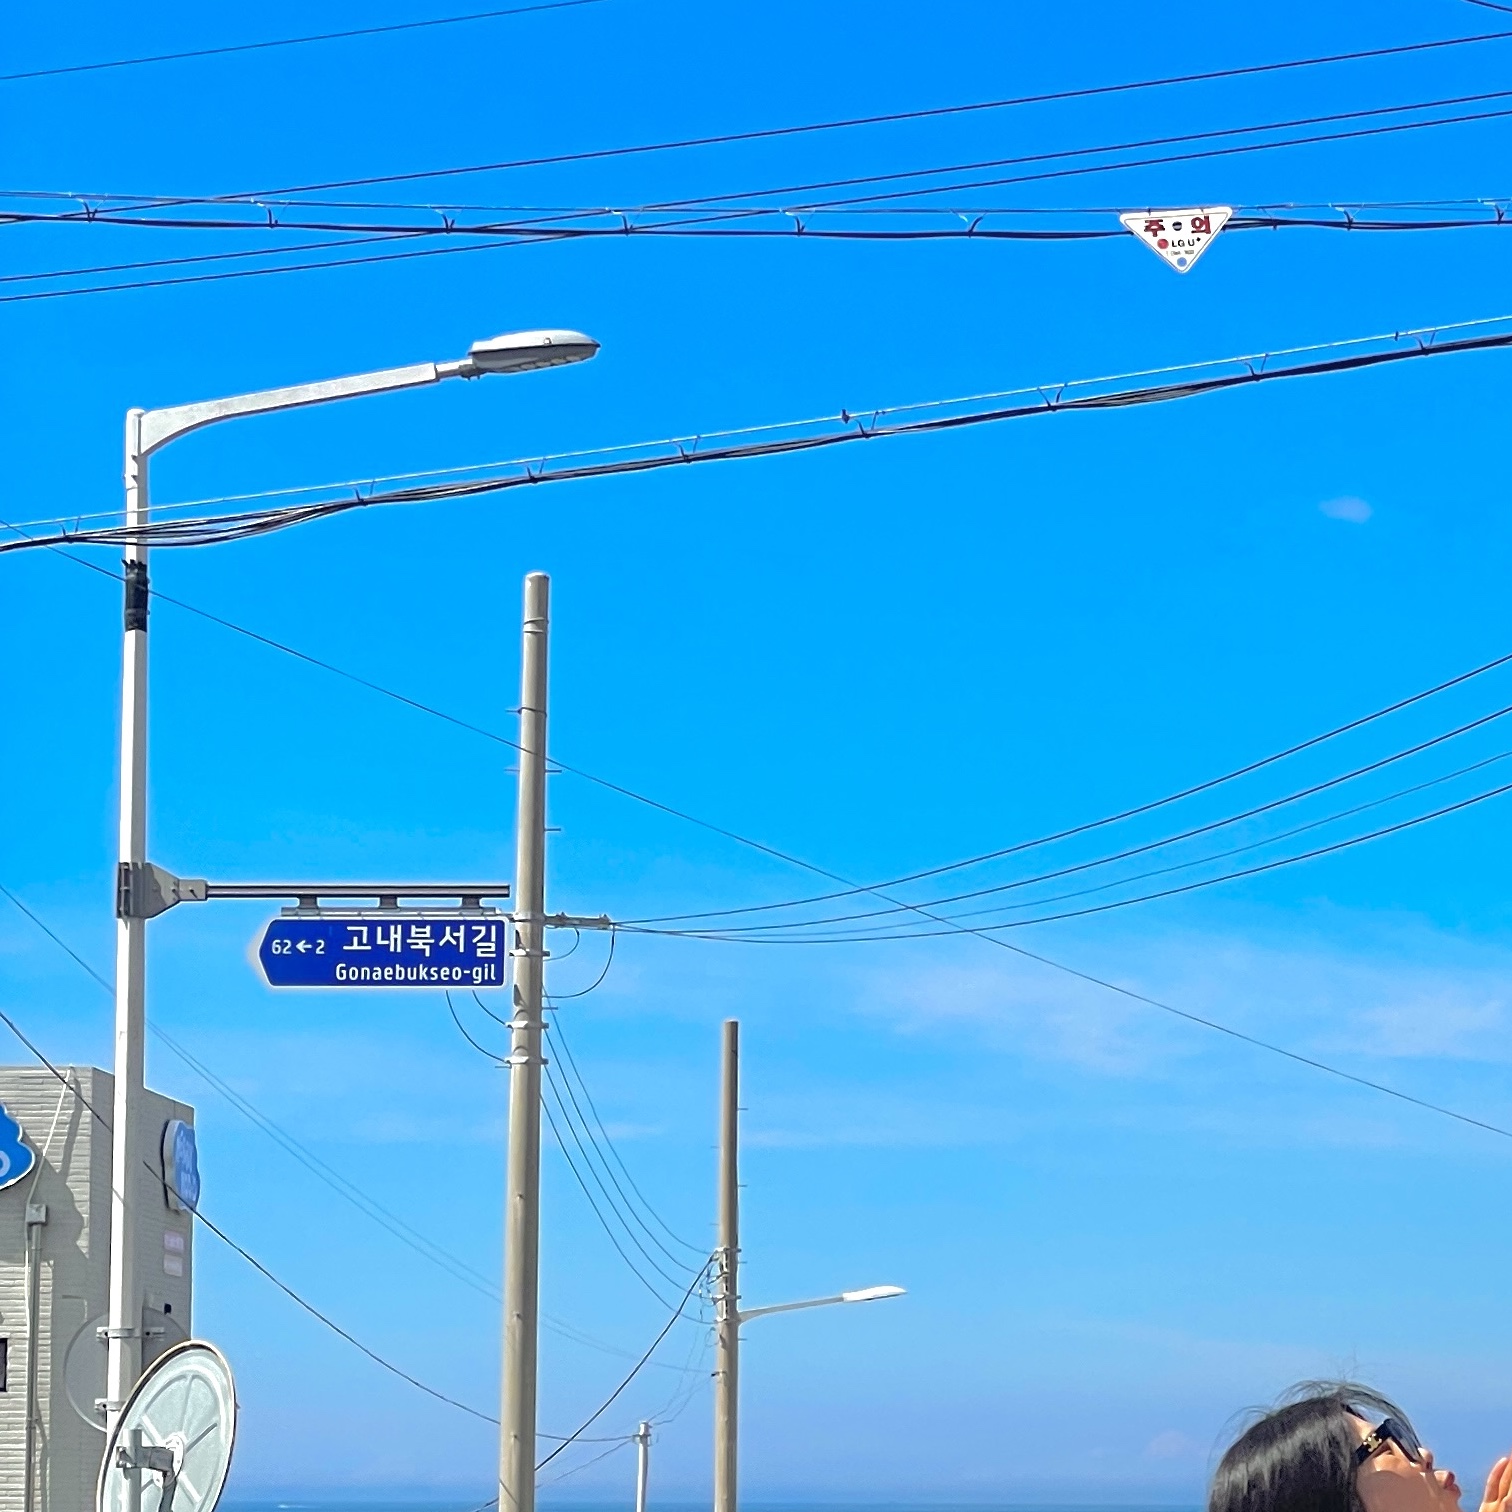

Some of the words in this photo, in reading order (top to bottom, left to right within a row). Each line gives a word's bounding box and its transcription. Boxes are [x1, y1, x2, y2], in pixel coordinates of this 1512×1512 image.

[1144, 215, 1211, 237] 주의
[1171, 239, 1185, 248] LG
[271, 939, 293, 955] 62
[315, 939, 325, 955] 2
[342, 924, 498, 958] 고내북서길
[335, 962, 497, 984] Gonaebukseo-gil
